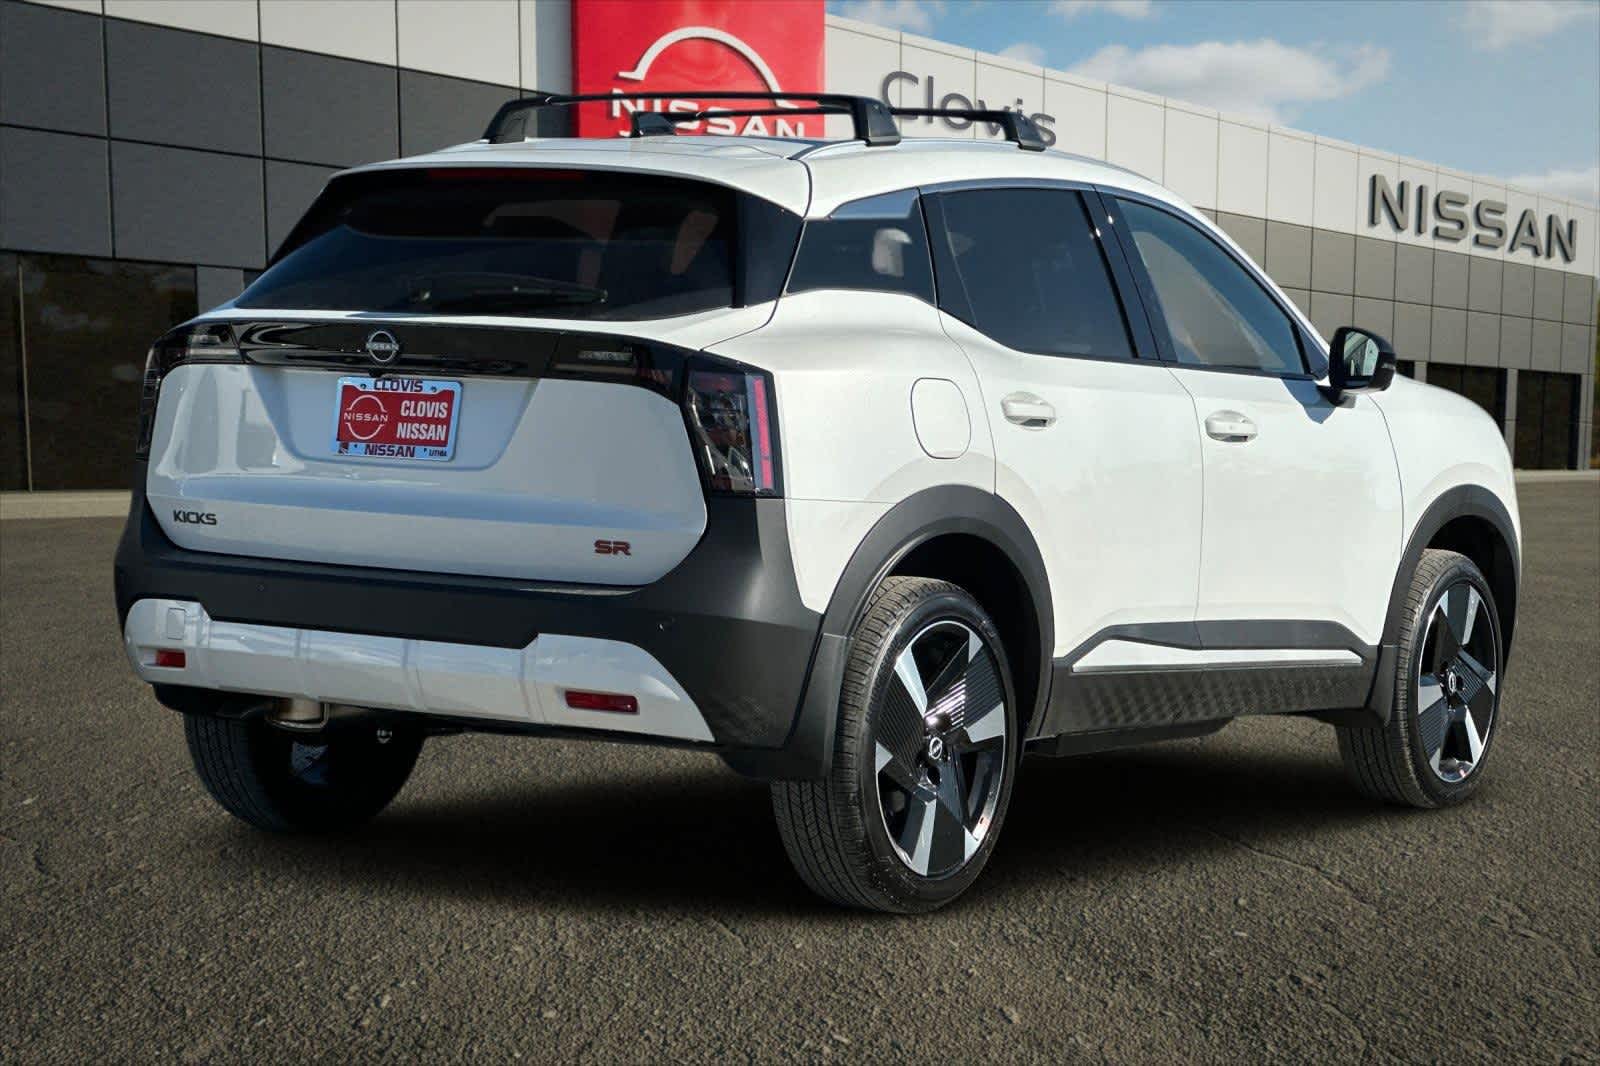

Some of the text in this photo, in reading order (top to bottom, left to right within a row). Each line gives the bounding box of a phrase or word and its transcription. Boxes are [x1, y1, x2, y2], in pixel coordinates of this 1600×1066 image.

[1368, 174, 1578, 264] NISSAN
[374, 377, 424, 392] CLOVIS
[343, 411, 388, 422] NISSAN
[400, 400, 448, 418] CLOVIS
[396, 422, 447, 441] NISSAN
[364, 444, 416, 457] NISSAN
[173, 510, 217, 526] KICKS
[594, 539, 632, 556] SR
